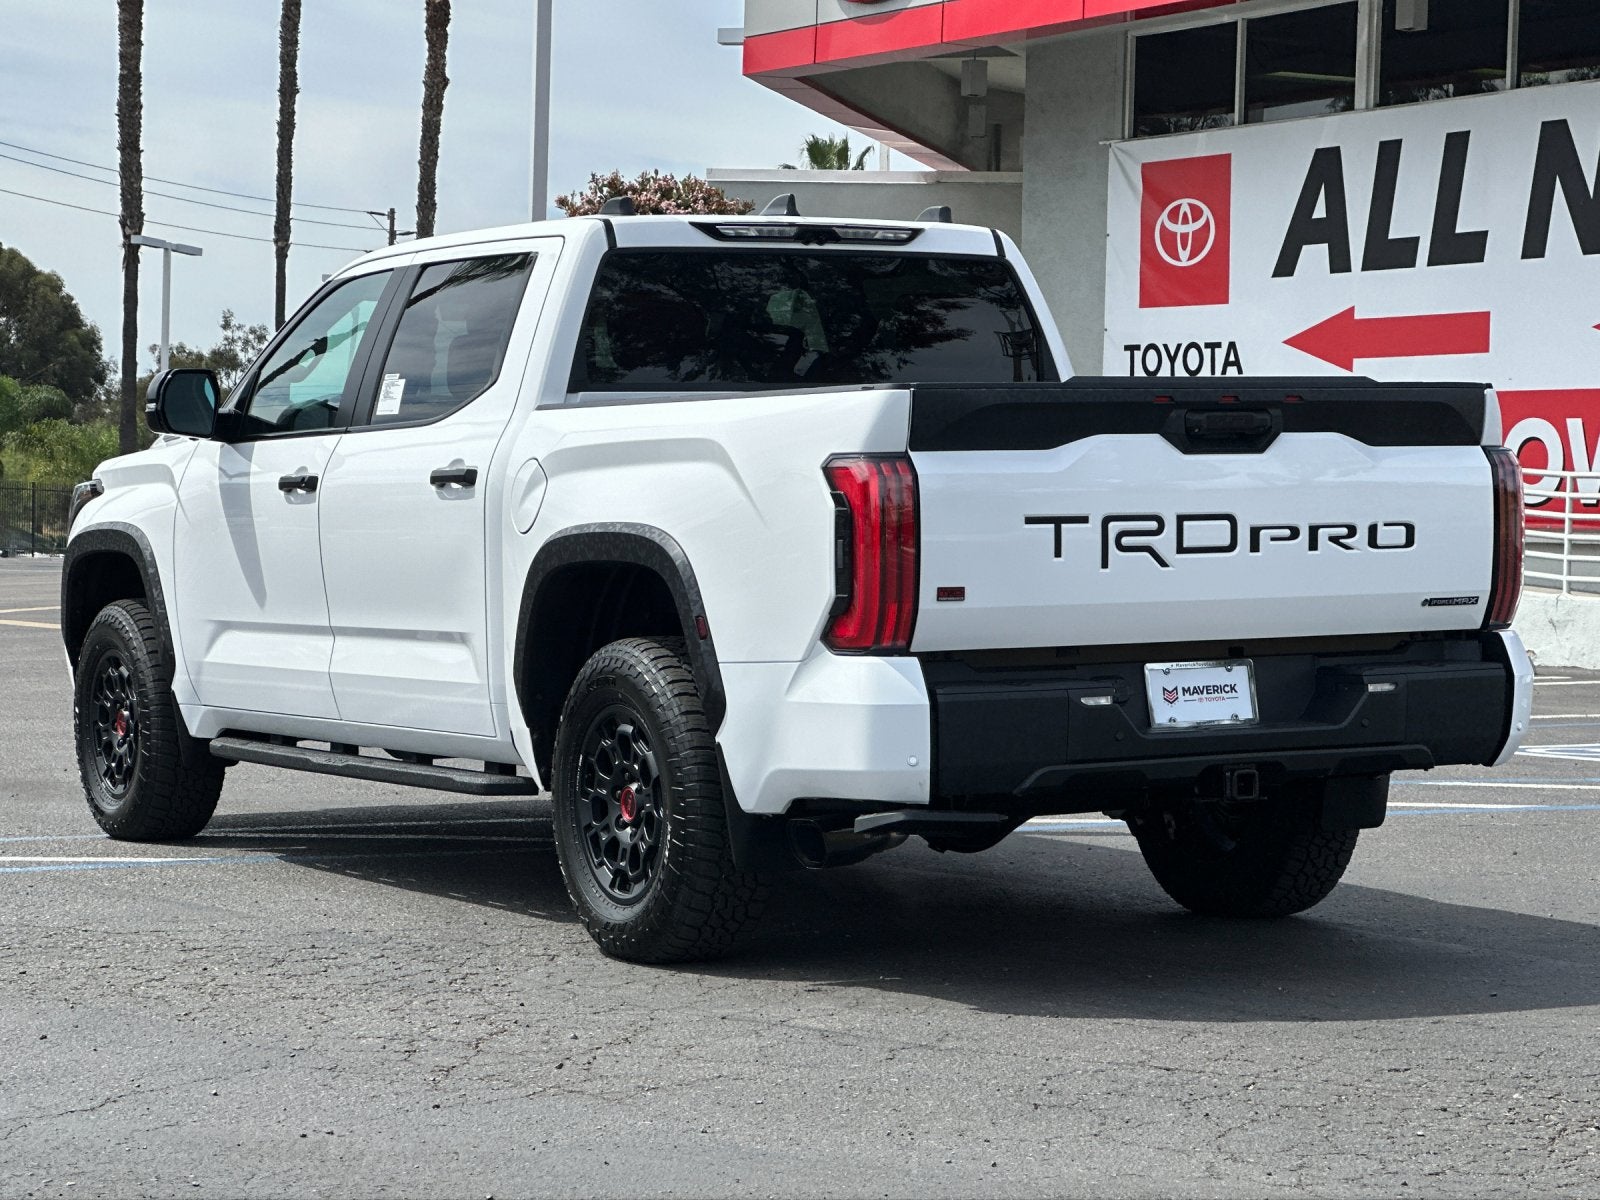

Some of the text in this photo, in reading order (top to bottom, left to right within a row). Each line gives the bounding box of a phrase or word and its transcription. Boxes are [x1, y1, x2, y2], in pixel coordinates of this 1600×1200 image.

[1271, 130, 1489, 278] ALL
[1123, 341, 1244, 376] TOYOTA
[1181, 683, 1238, 697] MAVERICK
